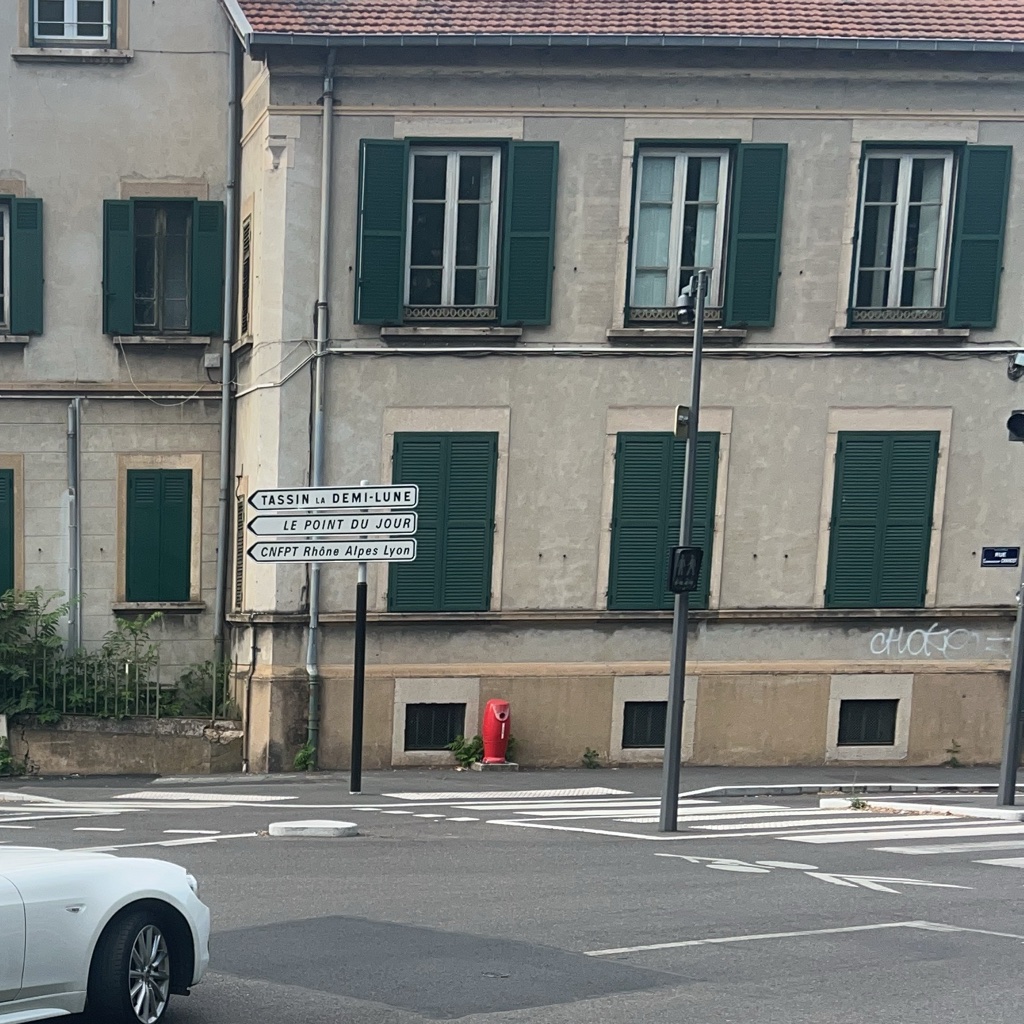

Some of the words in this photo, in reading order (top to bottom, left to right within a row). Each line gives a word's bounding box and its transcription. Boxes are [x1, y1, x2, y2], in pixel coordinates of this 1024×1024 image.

[261, 494, 310, 506] TASSIN
[332, 491, 411, 504] DEMI-LUNE
[283, 520, 298, 531] LE
[304, 519, 344, 530] POINT
[351, 518, 369, 530] DU
[376, 518, 411, 529] JOUR
[260, 546, 299, 558] CNFPT
[303, 545, 340, 557] Rhône
[344, 545, 378, 558] Alpes
[383, 545, 410, 558] Lyon
